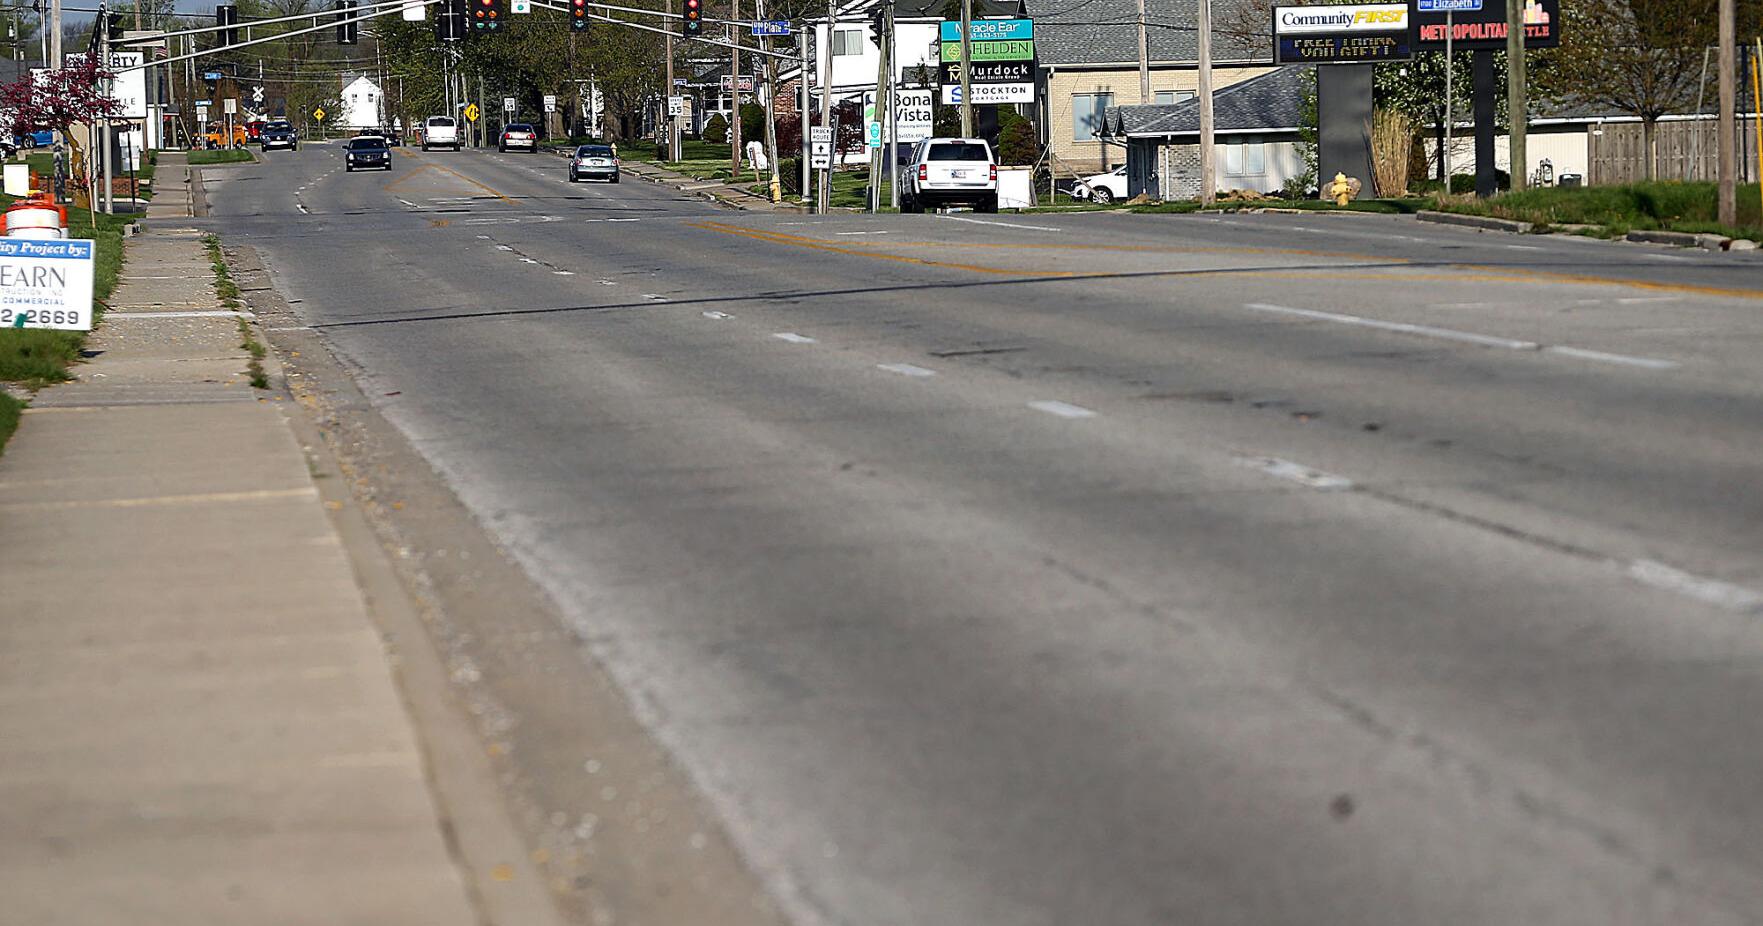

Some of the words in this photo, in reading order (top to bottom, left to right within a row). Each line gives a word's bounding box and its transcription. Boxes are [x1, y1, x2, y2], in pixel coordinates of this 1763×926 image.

[970, 42, 1029, 54] HELDEN
[971, 86, 1026, 95] STOCKTON
[896, 93, 931, 107] Bona
[670, 106, 682, 114] 35
[896, 108, 932, 122] Vista
[0, 241, 18, 254] ity
[20, 242, 66, 256] Project
[68, 243, 88, 257] by:
[0, 265, 66, 288] EARN
[2, 296, 65, 306] COMMERCIAL
